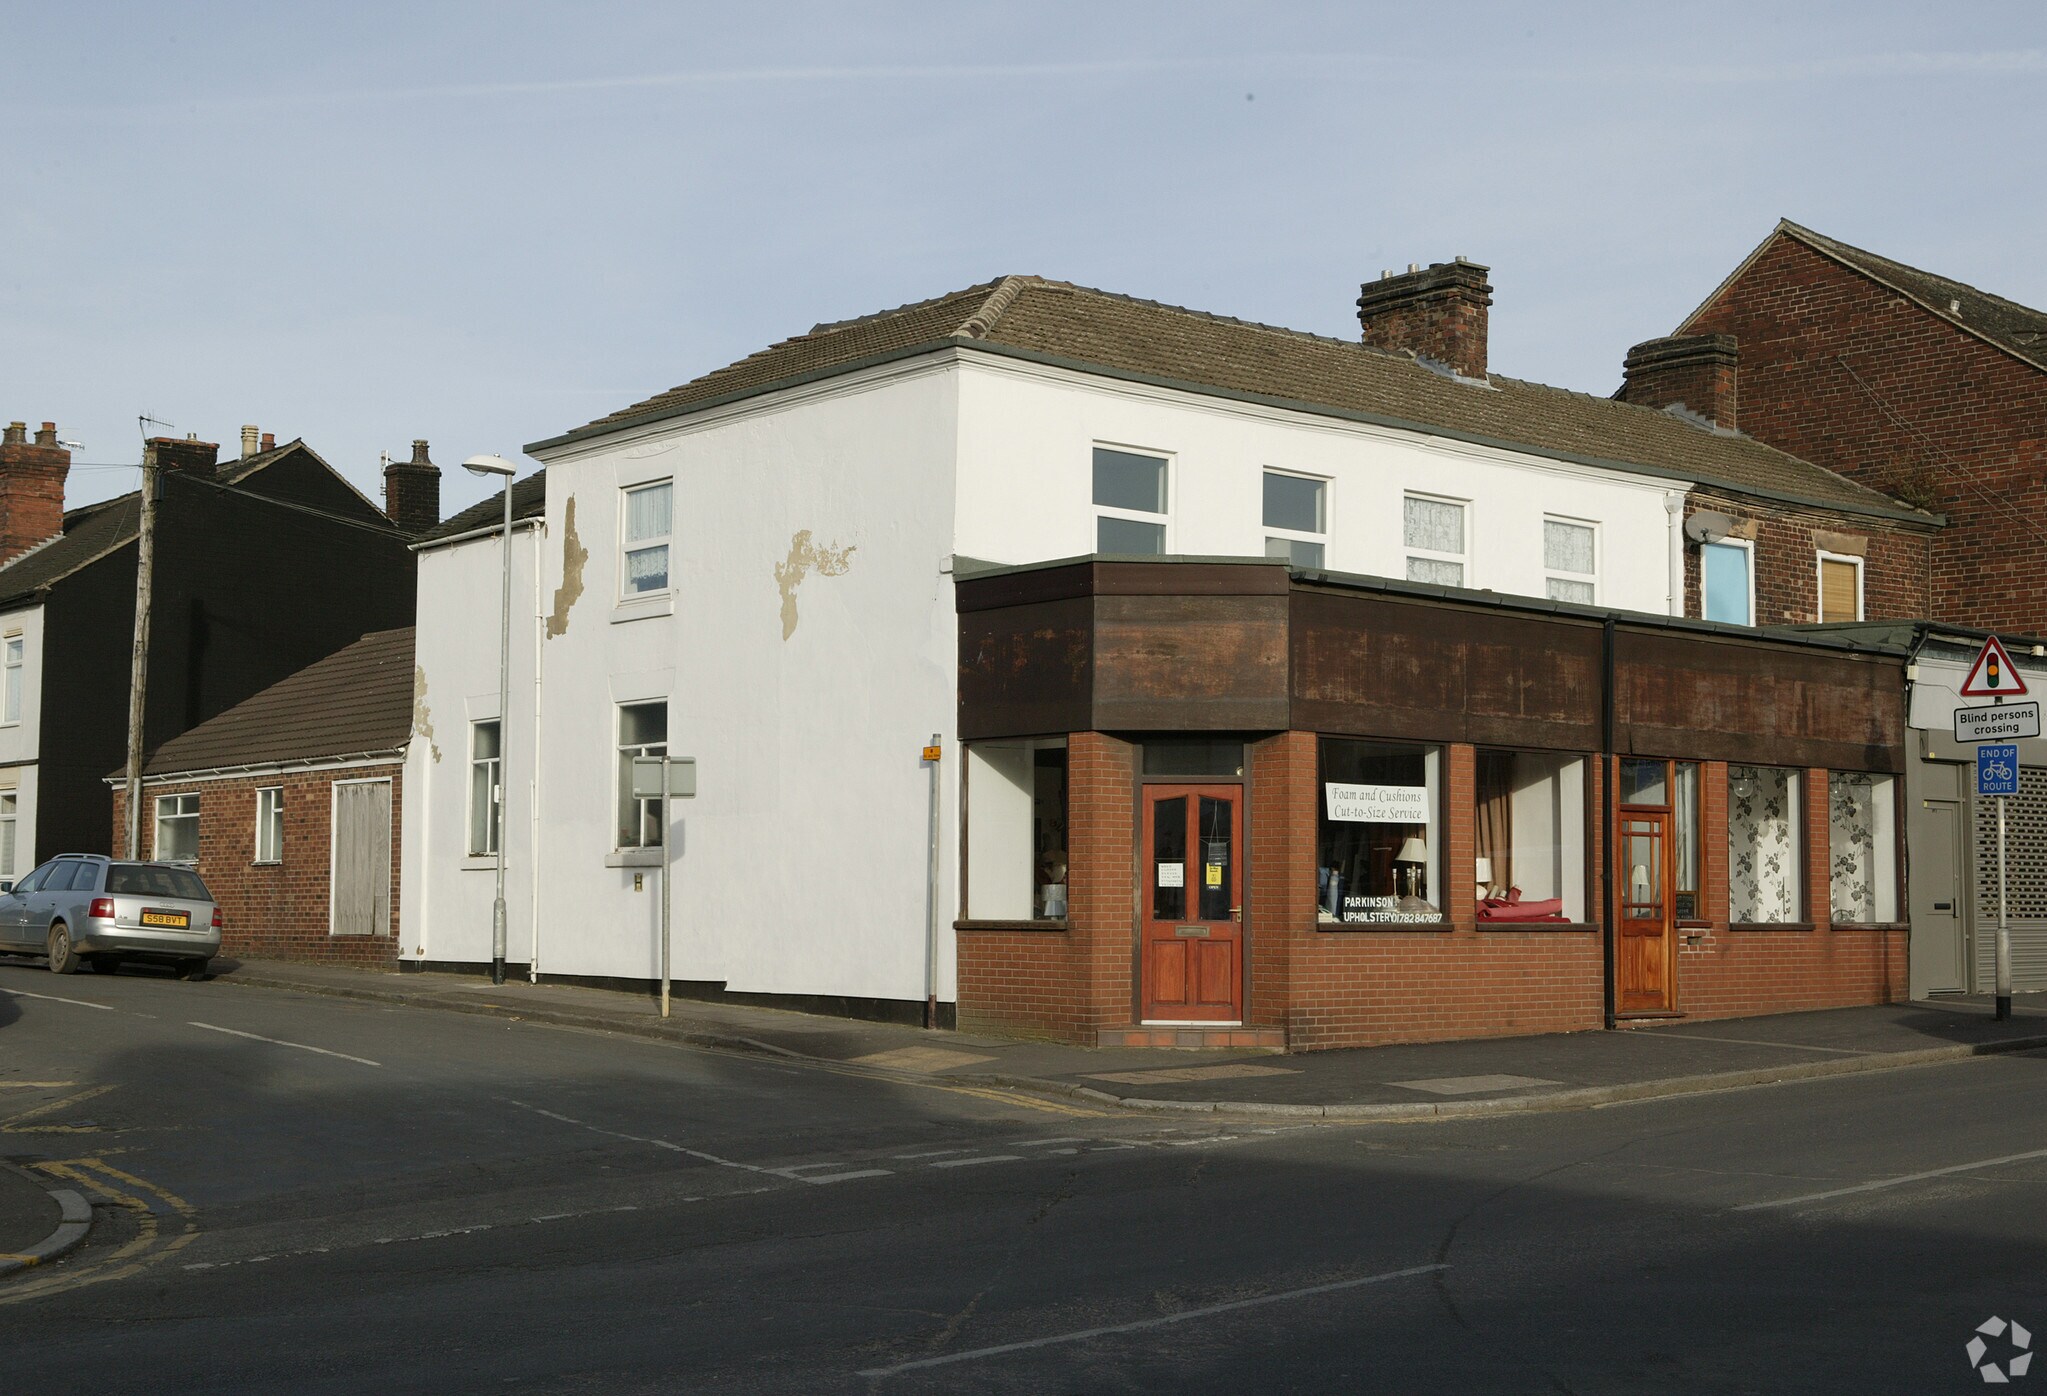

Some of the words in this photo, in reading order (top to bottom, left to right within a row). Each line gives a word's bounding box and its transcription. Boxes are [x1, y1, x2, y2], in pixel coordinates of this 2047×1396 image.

[1960, 712, 1987, 723] Blind
[1991, 710, 2034, 722] persons
[1974, 723, 2019, 734] crossing
[1980, 750, 2000, 758] END
[2002, 749, 2015, 758] OF
[1983, 782, 2012, 791] ROUTE
[1332, 787, 1357, 800] Foam
[1360, 788, 1377, 801] and
[1379, 789, 1422, 803] Cushions
[1335, 804, 1386, 819] Cut-to-Size
[1388, 807, 1422, 819] Service
[147, 914, 164, 923] S58
[165, 915, 182, 924] BVT
[1343, 912, 1394, 923] UPHOLSTERY
[1392, 912, 1415, 924] 01782
[1415, 912, 1443, 924] 847687
